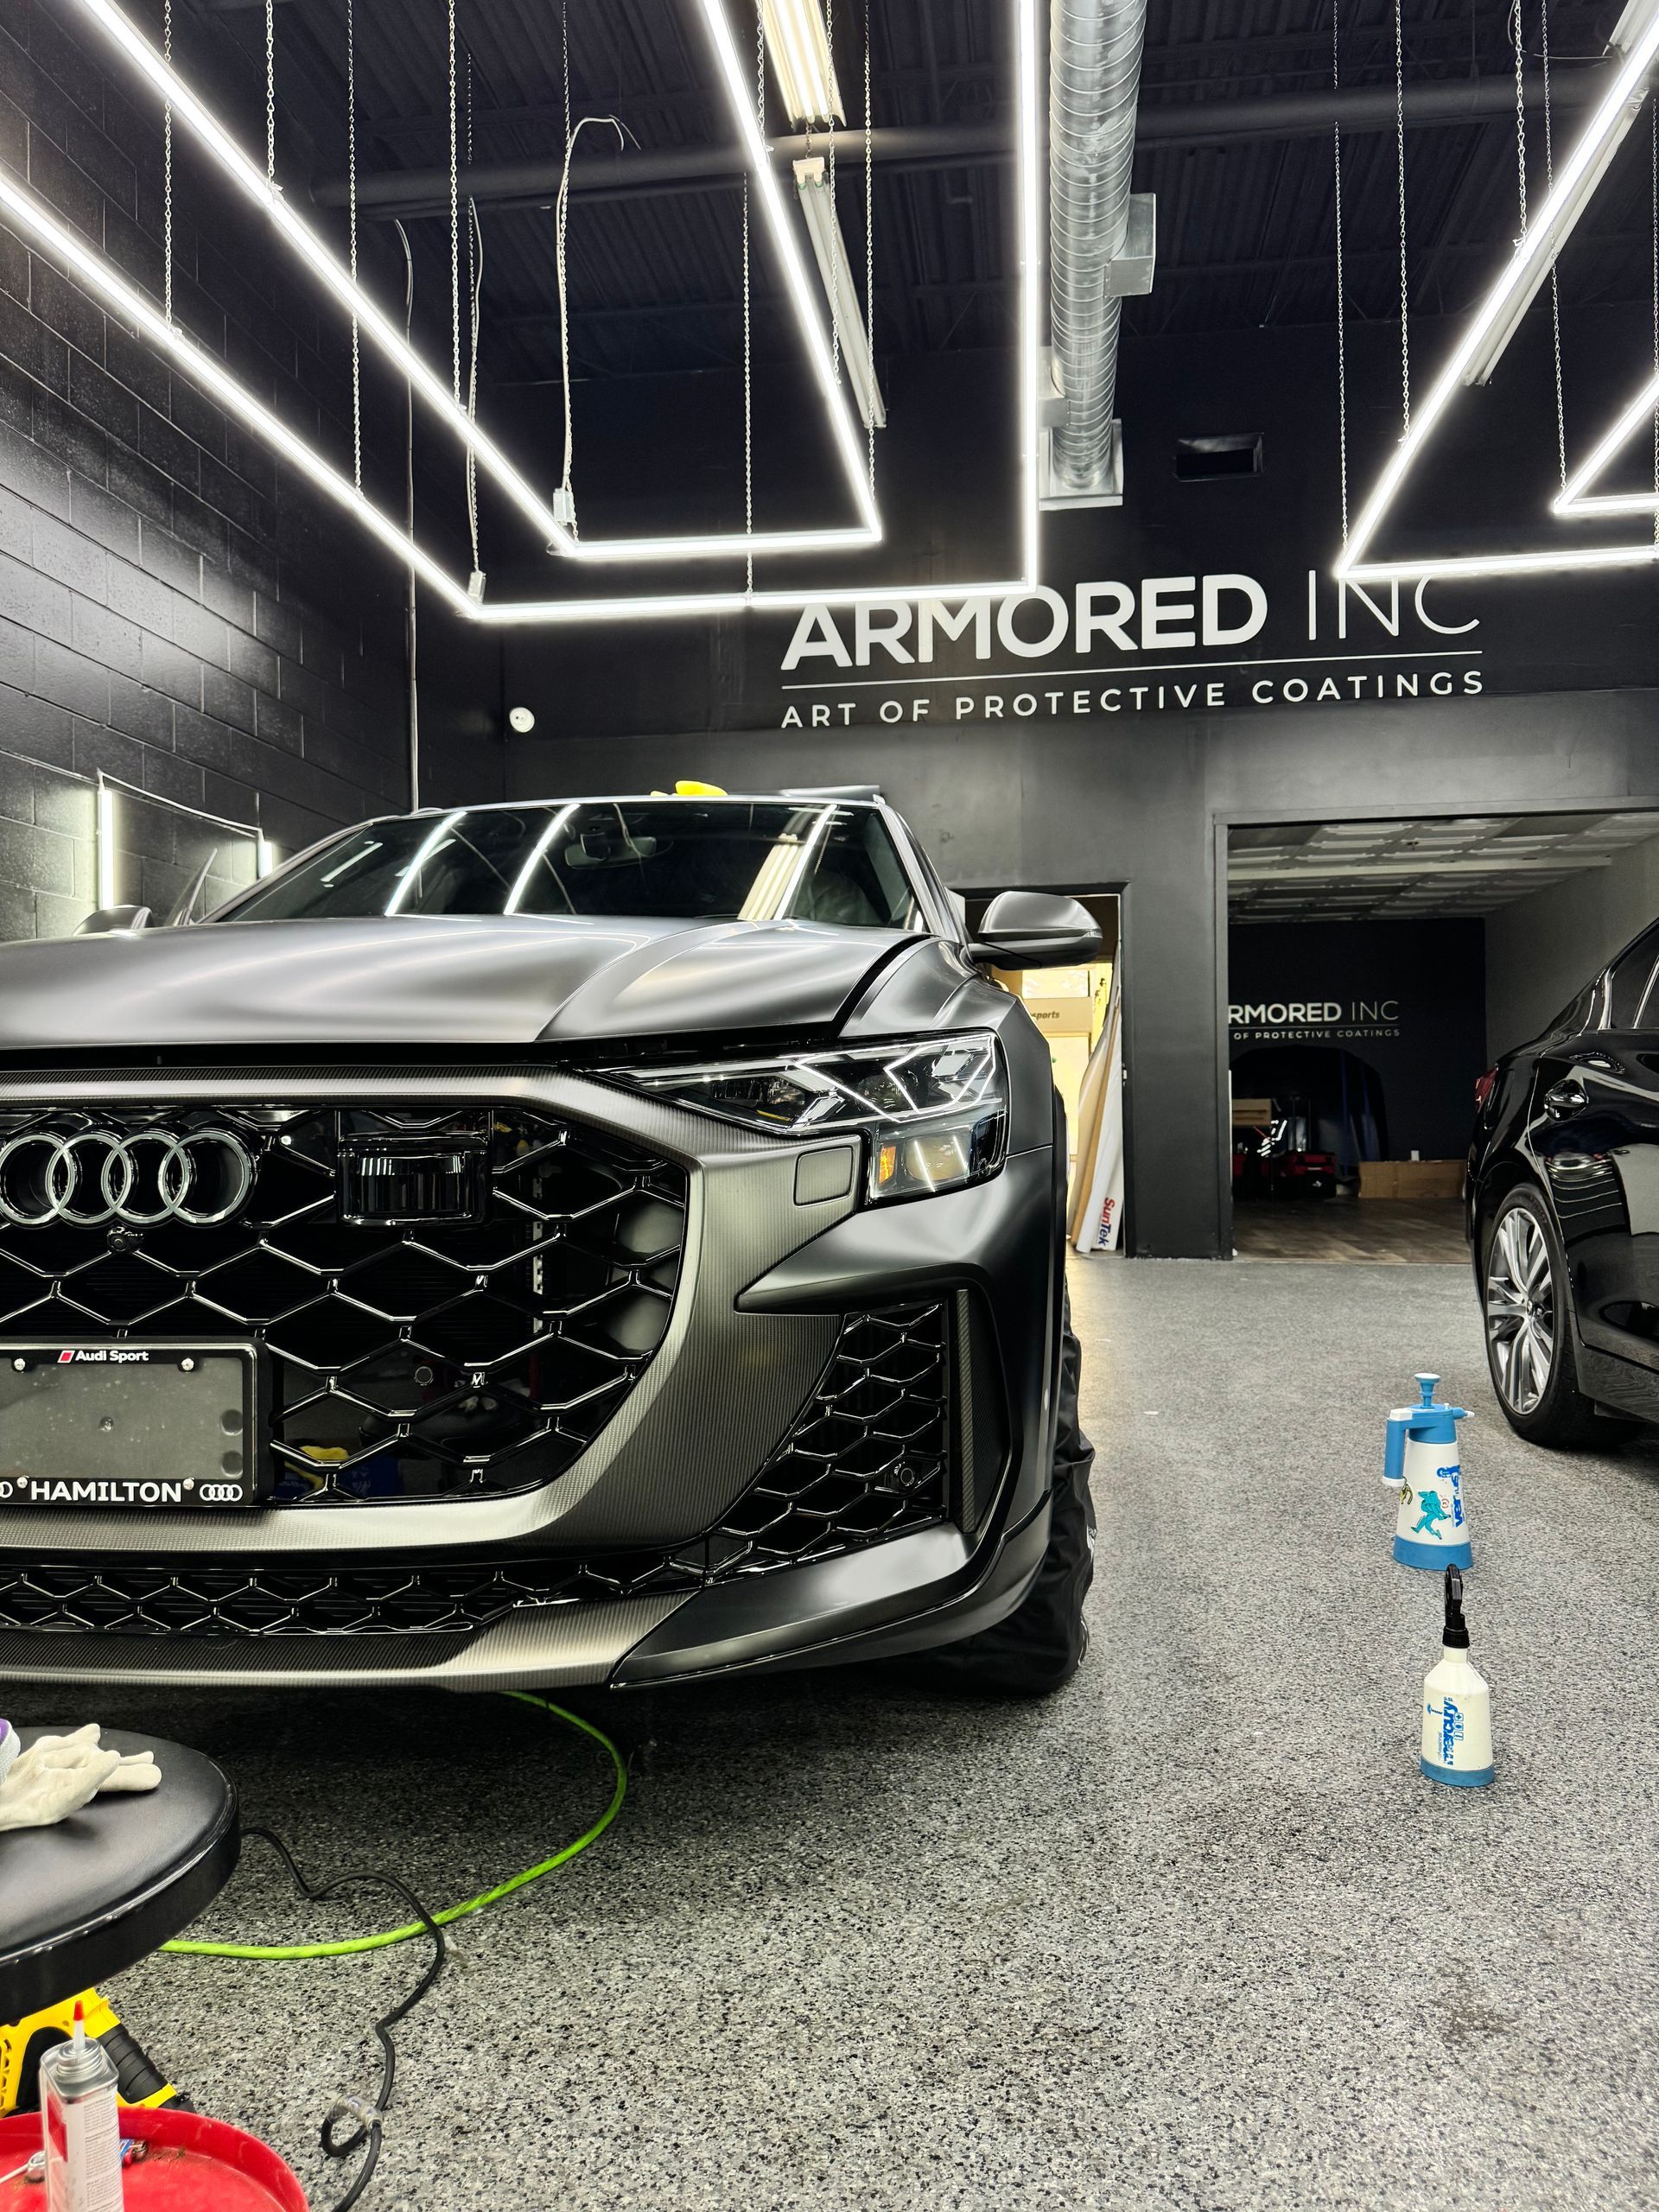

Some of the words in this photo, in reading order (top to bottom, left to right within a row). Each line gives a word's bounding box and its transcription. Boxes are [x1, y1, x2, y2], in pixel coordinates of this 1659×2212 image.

[780, 573, 1268, 671] ARMORED
[1308, 568, 1481, 641] INC
[780, 702, 857, 728] ART
[879, 698, 930, 723] OF
[956, 683, 1226, 720] PROTECTIVE
[1252, 671, 1484, 704] COATINGS
[1351, 1000, 1399, 1021] INC
[1233, 1032, 1249, 1040] OF
[1255, 1030, 1331, 1040] PROTECTIVE
[1337, 1028, 1400, 1038] COATINGS
[1098, 1197, 1116, 1246] SunTek
[75, 1351, 107, 1362] Audi
[109, 1351, 149, 1363] Sport
[30, 1480, 182, 1503] HAMILTON
[1443, 1702, 1458, 1765] mercury
